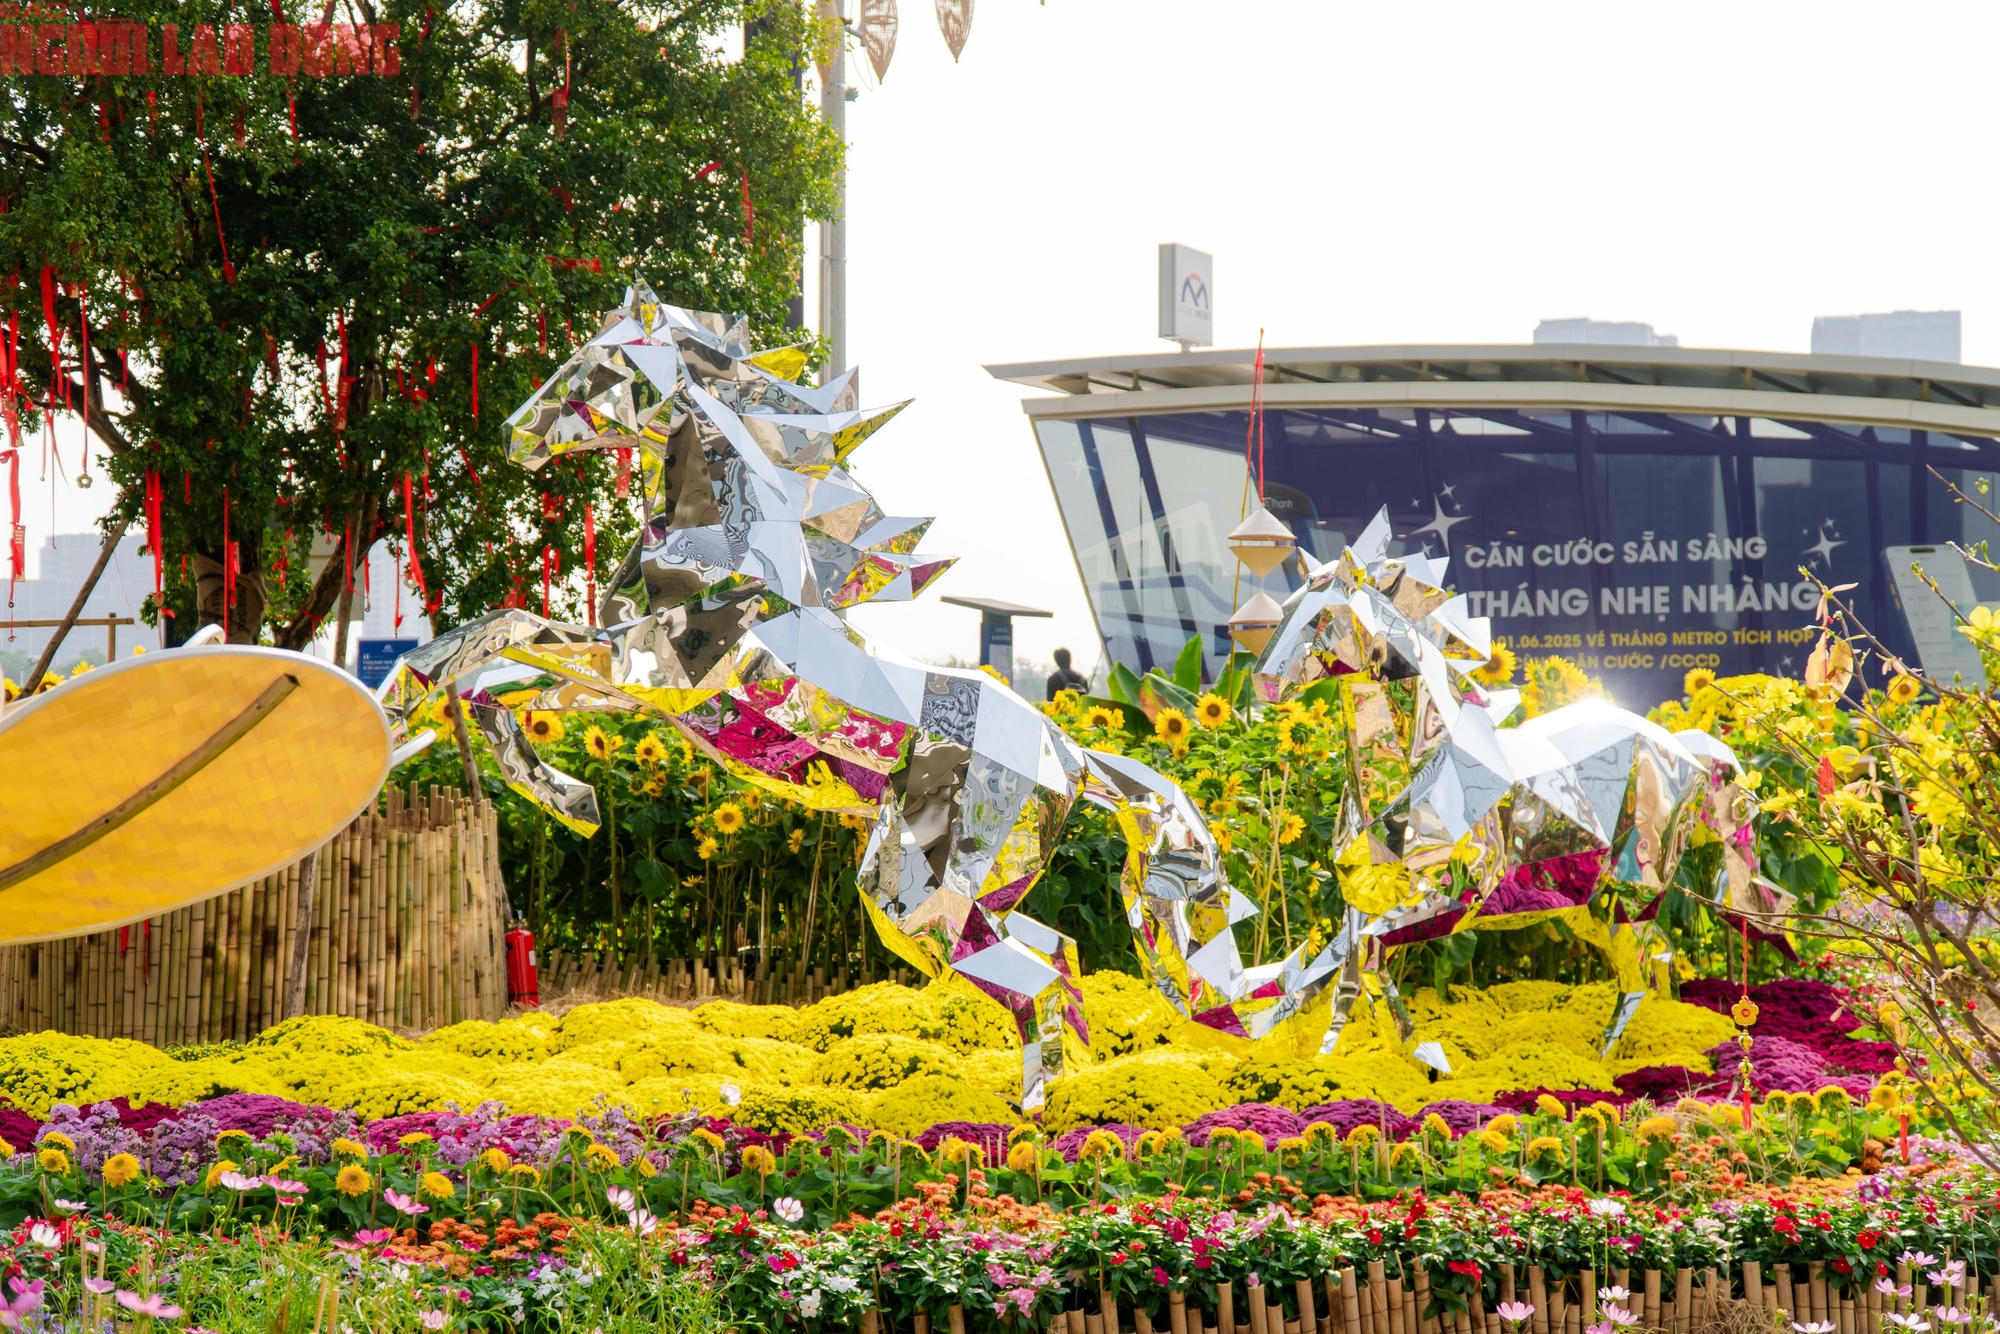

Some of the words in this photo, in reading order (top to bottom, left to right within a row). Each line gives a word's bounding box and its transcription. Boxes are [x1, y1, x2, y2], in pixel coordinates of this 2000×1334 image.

[1464, 541, 1524, 569] CĂN
[1532, 536, 1615, 567] CƯỚC
[1623, 530, 1679, 564] SẴN
[1687, 532, 1768, 561] SÀNG
[1468, 581, 1590, 618] THÁNG
[1601, 585, 1671, 622] NHẸ
[1682, 574, 1822, 613] NHÀNG
[1610, 628, 1668, 647] THÁNG
[1672, 631, 1728, 646] METRO
[1732, 626, 1772, 645] TÍCH
[1603, 651, 1654, 669] CƯỚC
[1660, 653, 1721, 670] /CCCD
